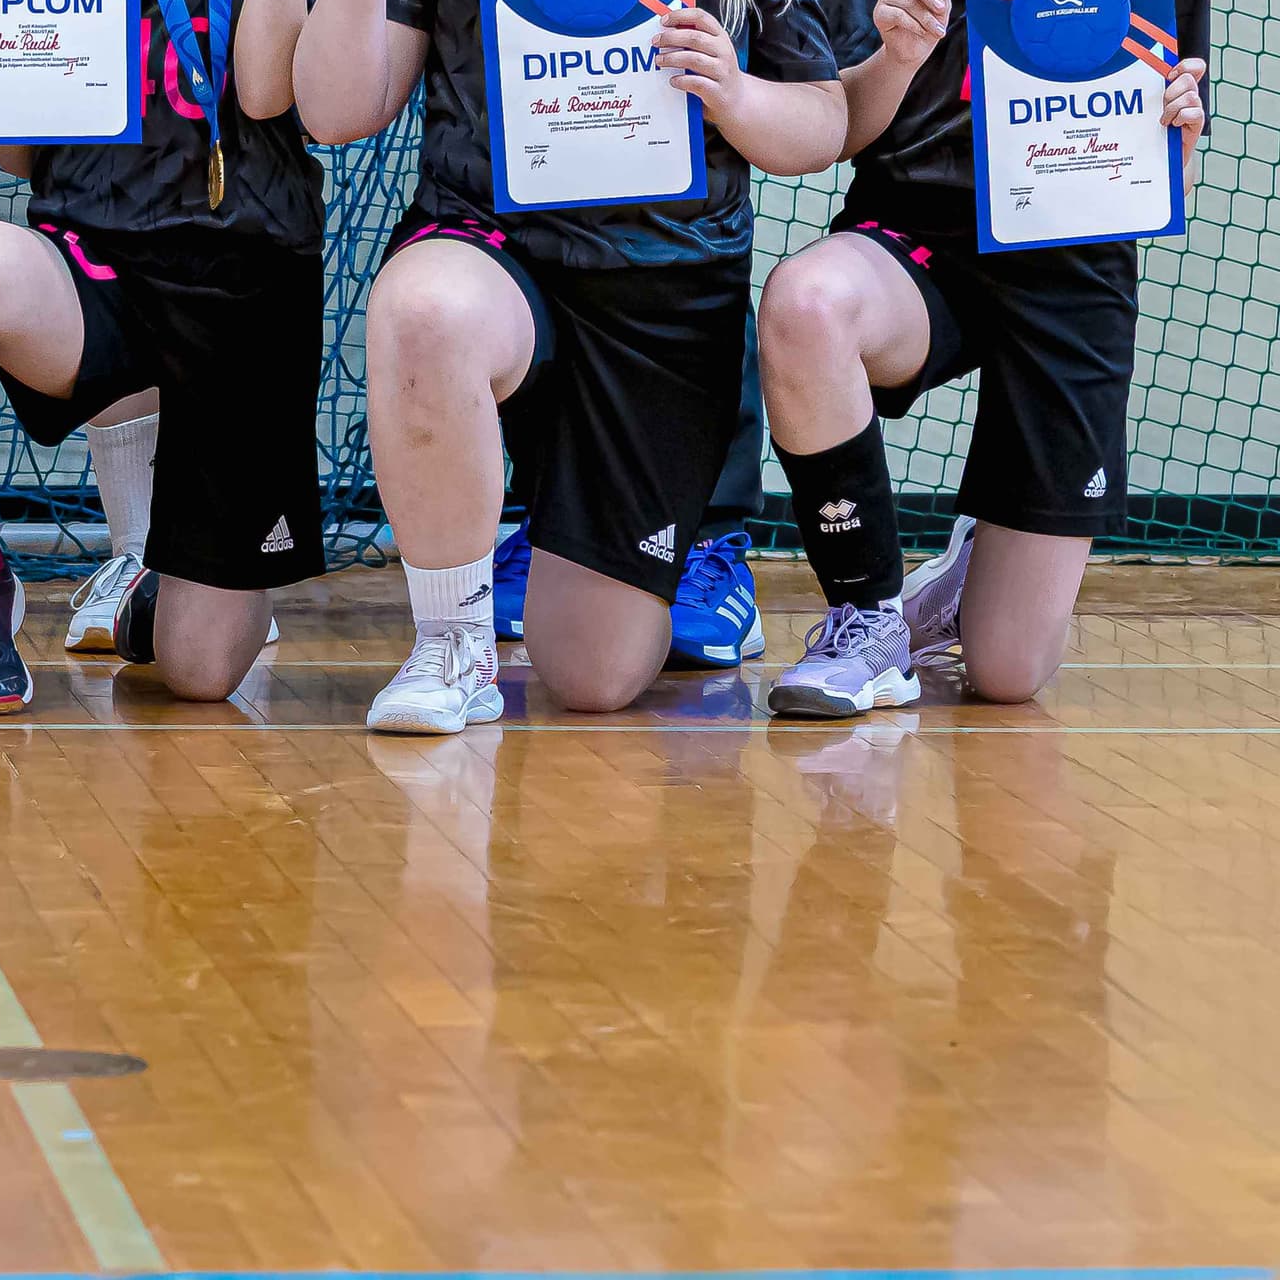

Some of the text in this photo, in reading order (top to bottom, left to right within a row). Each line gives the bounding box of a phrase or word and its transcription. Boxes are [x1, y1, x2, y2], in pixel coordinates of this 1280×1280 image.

[19, 33, 61, 50] Rudik
[523, 47, 660, 80] DIPLOM
[567, 94, 632, 117] Roosimägi
[1009, 89, 1144, 125] DIPLOM
[1025, 142, 1077, 167] Johanna
[261, 538, 293, 552] adidas
[639, 540, 675, 563] adidas
